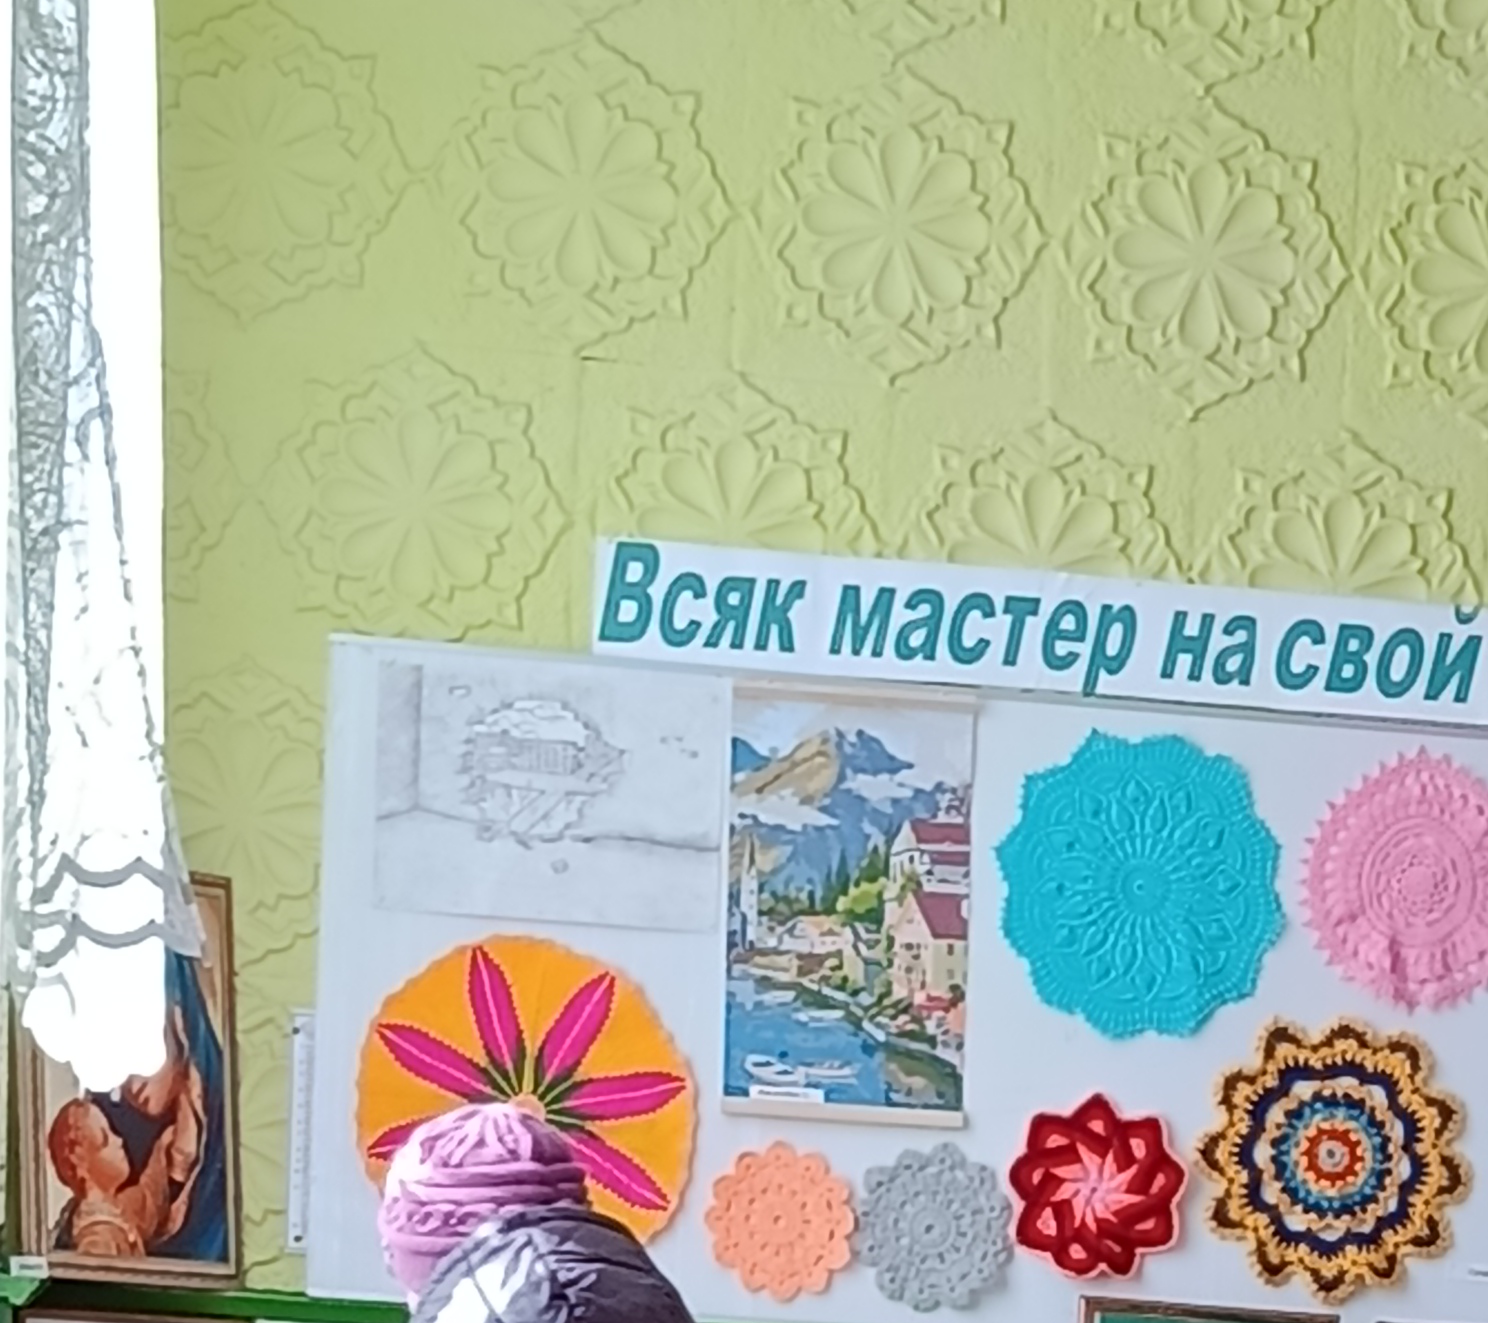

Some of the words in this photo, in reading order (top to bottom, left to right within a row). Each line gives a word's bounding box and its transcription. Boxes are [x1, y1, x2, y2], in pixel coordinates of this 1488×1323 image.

[598, 541, 807, 654] Всяк
[828, 584, 1138, 697] мастер
[1160, 610, 1257, 687] на
[1275, 601, 1484, 704] свой
